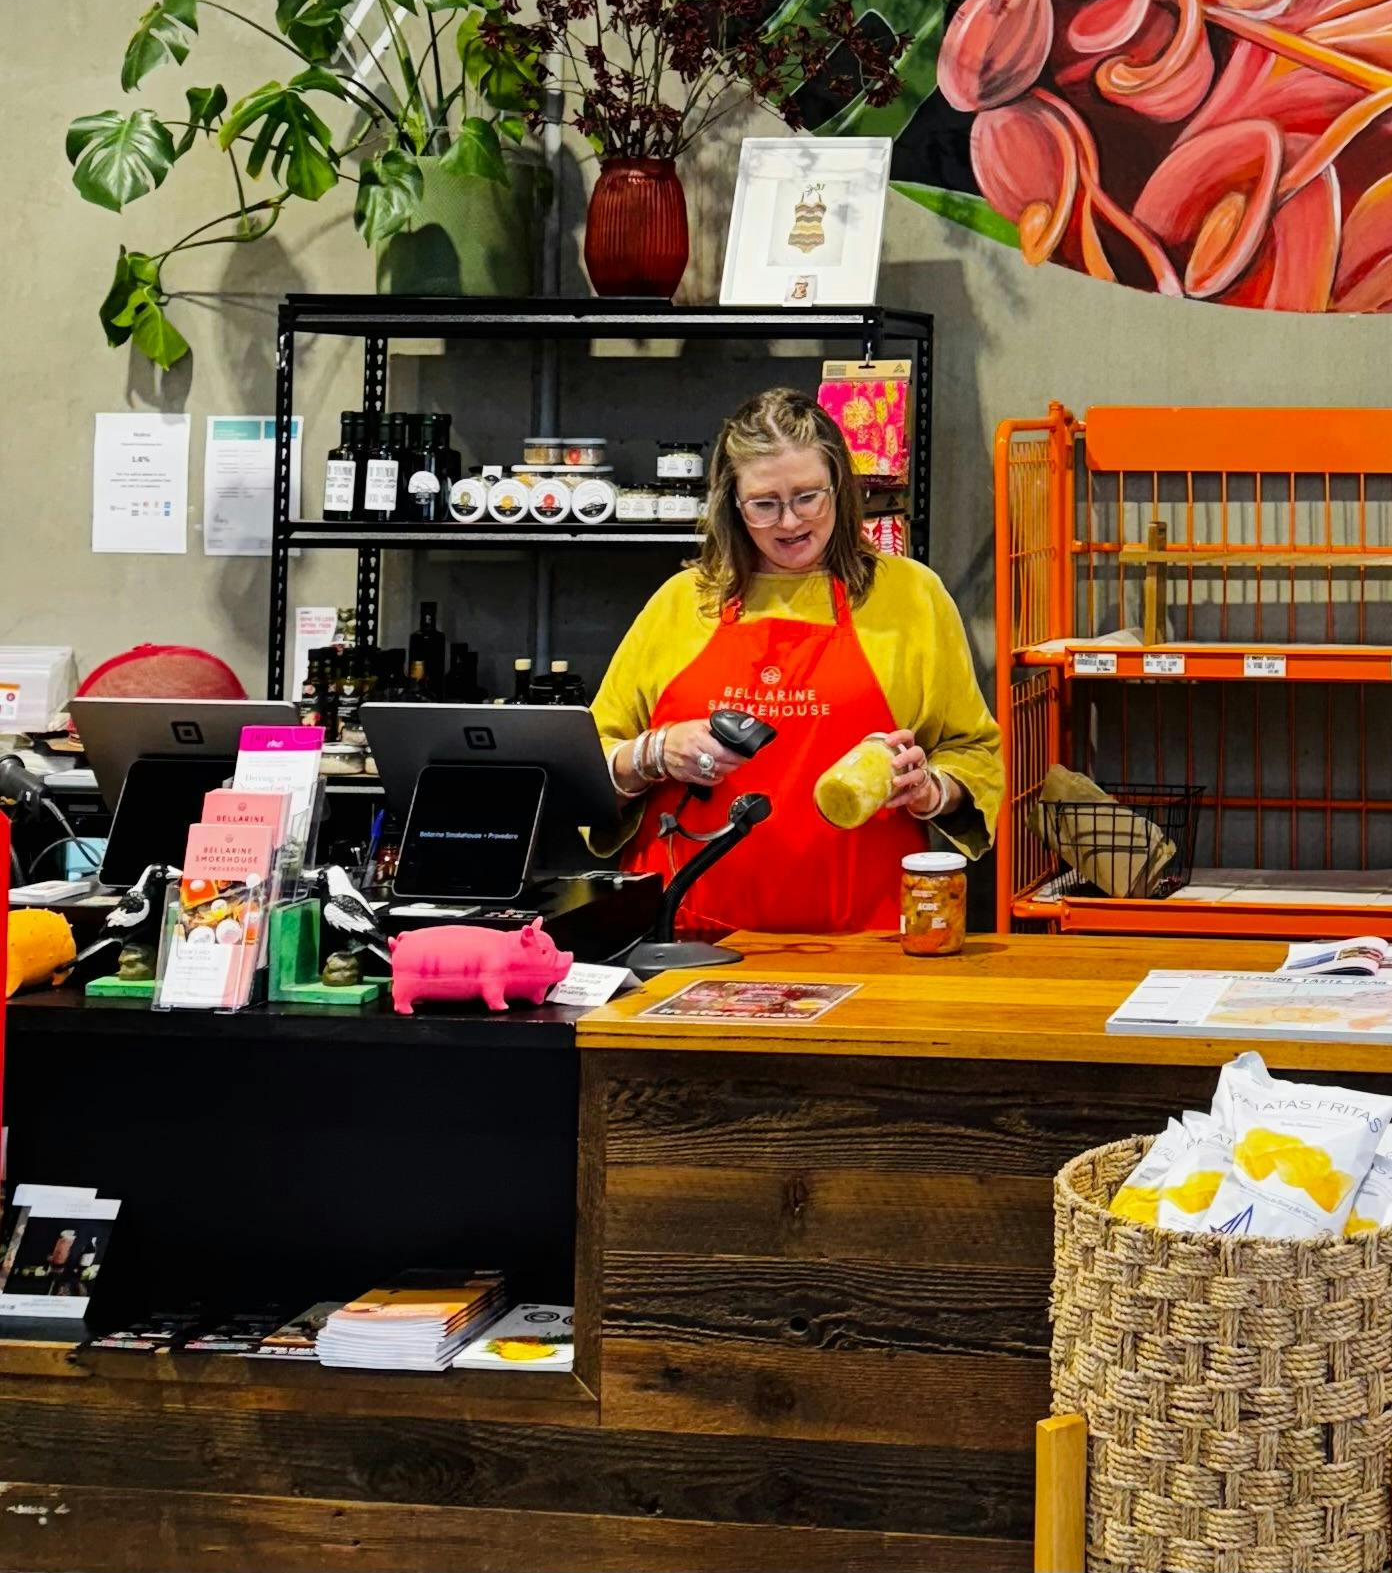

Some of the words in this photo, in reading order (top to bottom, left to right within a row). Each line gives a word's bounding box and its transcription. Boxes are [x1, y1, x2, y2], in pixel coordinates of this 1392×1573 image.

[724, 686, 816, 701] BELLARINE
[708, 699, 830, 716] SMOKEHOUSE
[216, 815, 265, 823] BELLARINE
[203, 847, 253, 855] BELLARINE
[195, 856, 258, 864] SMOKEHOUSE
[1317, 1099, 1382, 1134] FRITAS
